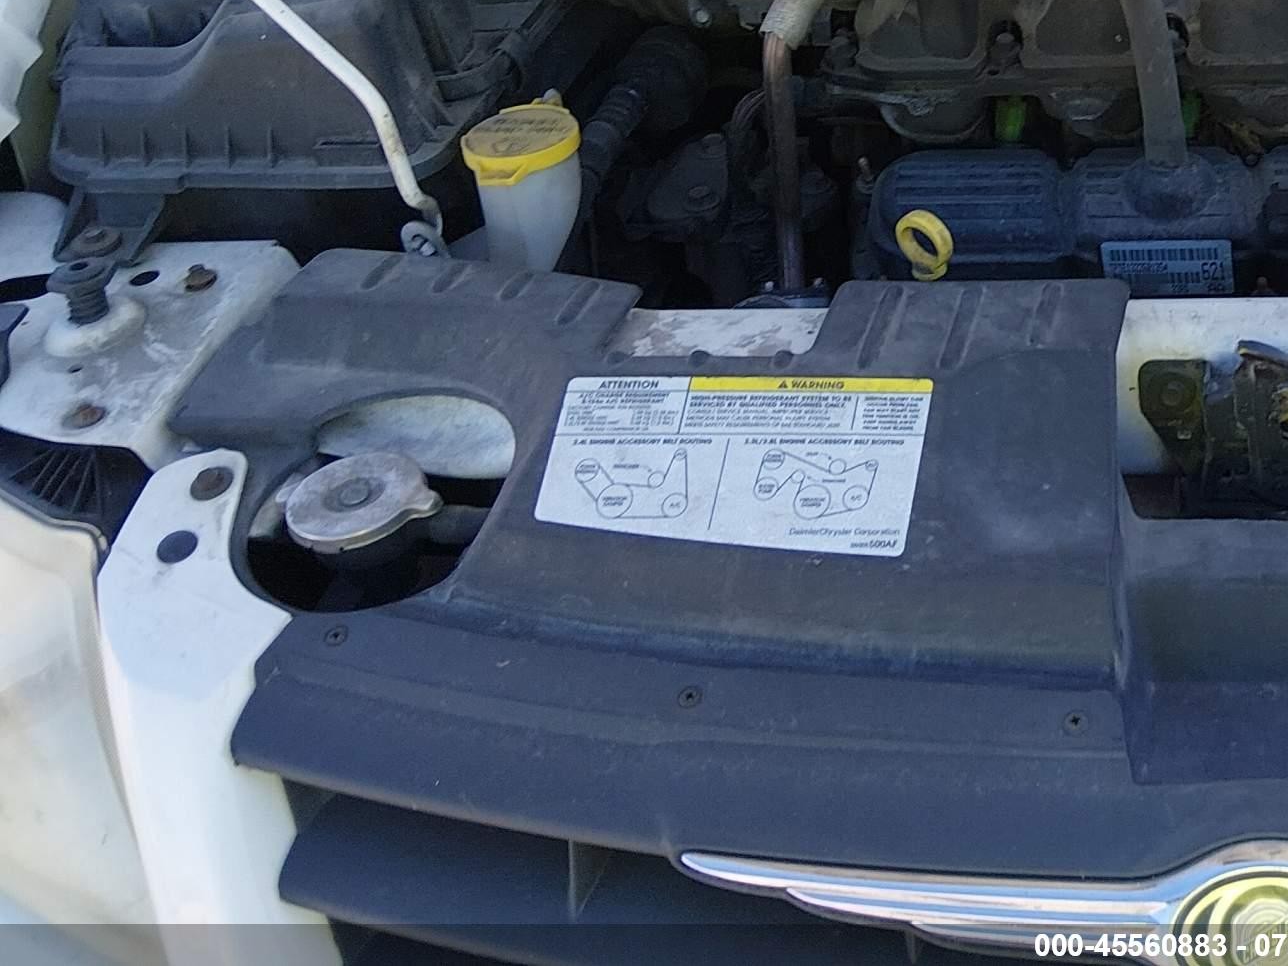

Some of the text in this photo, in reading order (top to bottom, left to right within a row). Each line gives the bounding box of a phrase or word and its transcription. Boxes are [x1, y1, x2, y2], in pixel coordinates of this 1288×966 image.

[598, 380, 660, 390] ATTENTION
[790, 380, 845, 390] WARNING
[853, 527, 900, 536] Corporation
